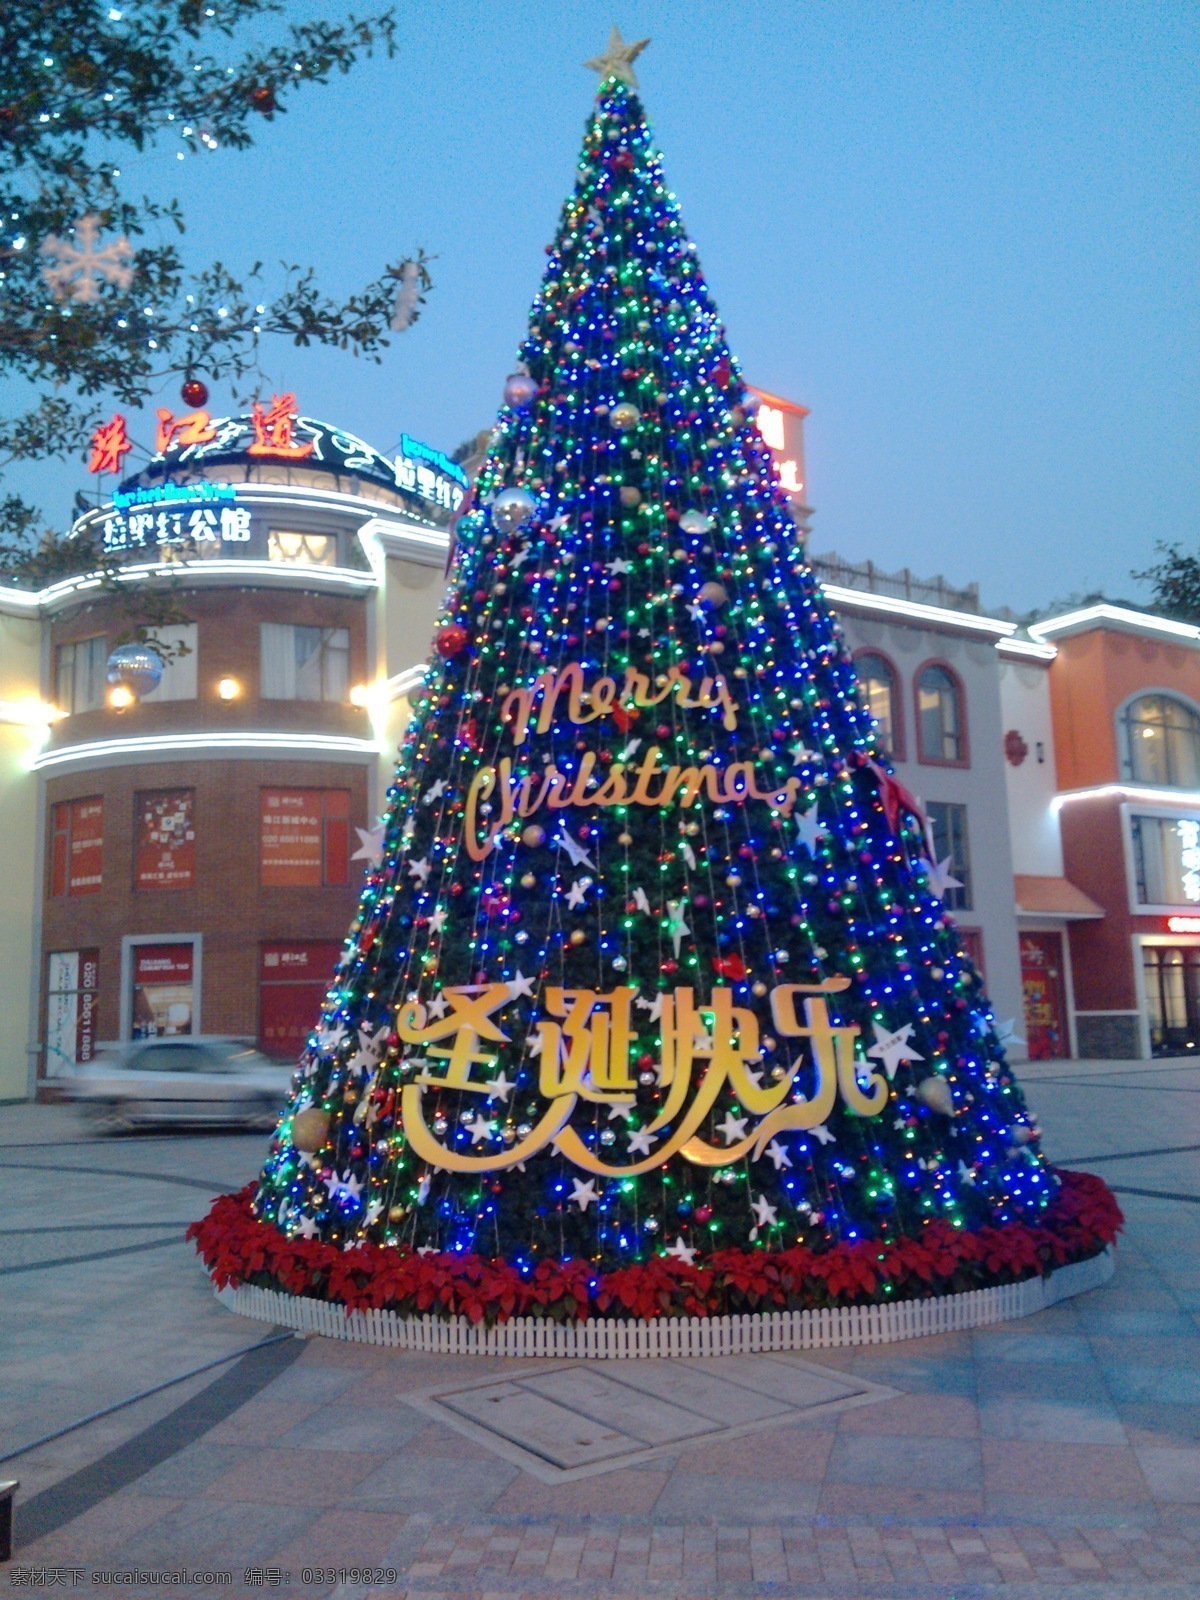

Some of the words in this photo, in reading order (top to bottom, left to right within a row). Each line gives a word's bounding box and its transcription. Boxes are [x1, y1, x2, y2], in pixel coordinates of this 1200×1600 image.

[502, 661, 739, 746] Merry
[464, 745, 801, 862] Christmas
[83, 962, 92, 988] 020
[397, 977, 888, 1177] 圣诞快乐
